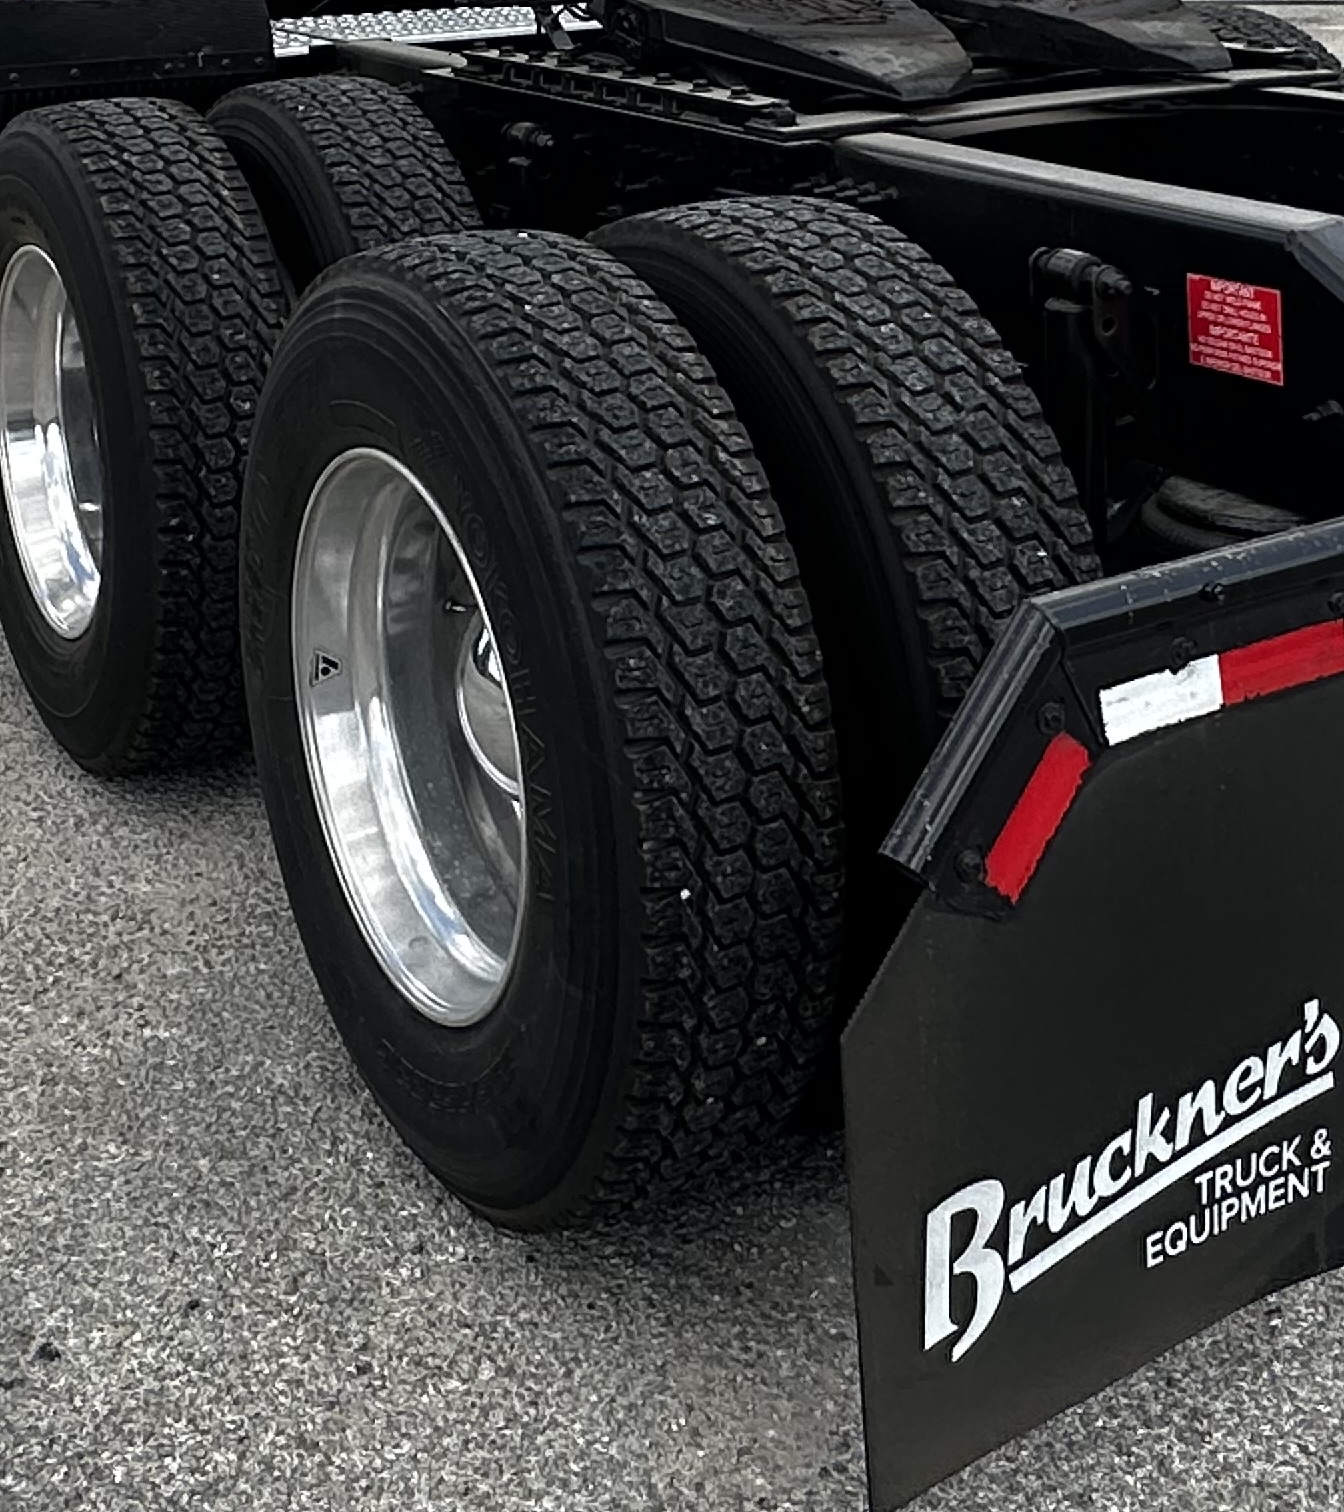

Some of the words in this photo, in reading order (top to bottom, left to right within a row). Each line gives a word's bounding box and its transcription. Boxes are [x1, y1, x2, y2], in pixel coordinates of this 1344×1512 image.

[923, 998, 1341, 1363] Bruckner's
[1146, 1160, 1332, 1268] EQUIPMENT
[1194, 1134, 1302, 1206] TRUCK
[1310, 1128, 1333, 1160] &
